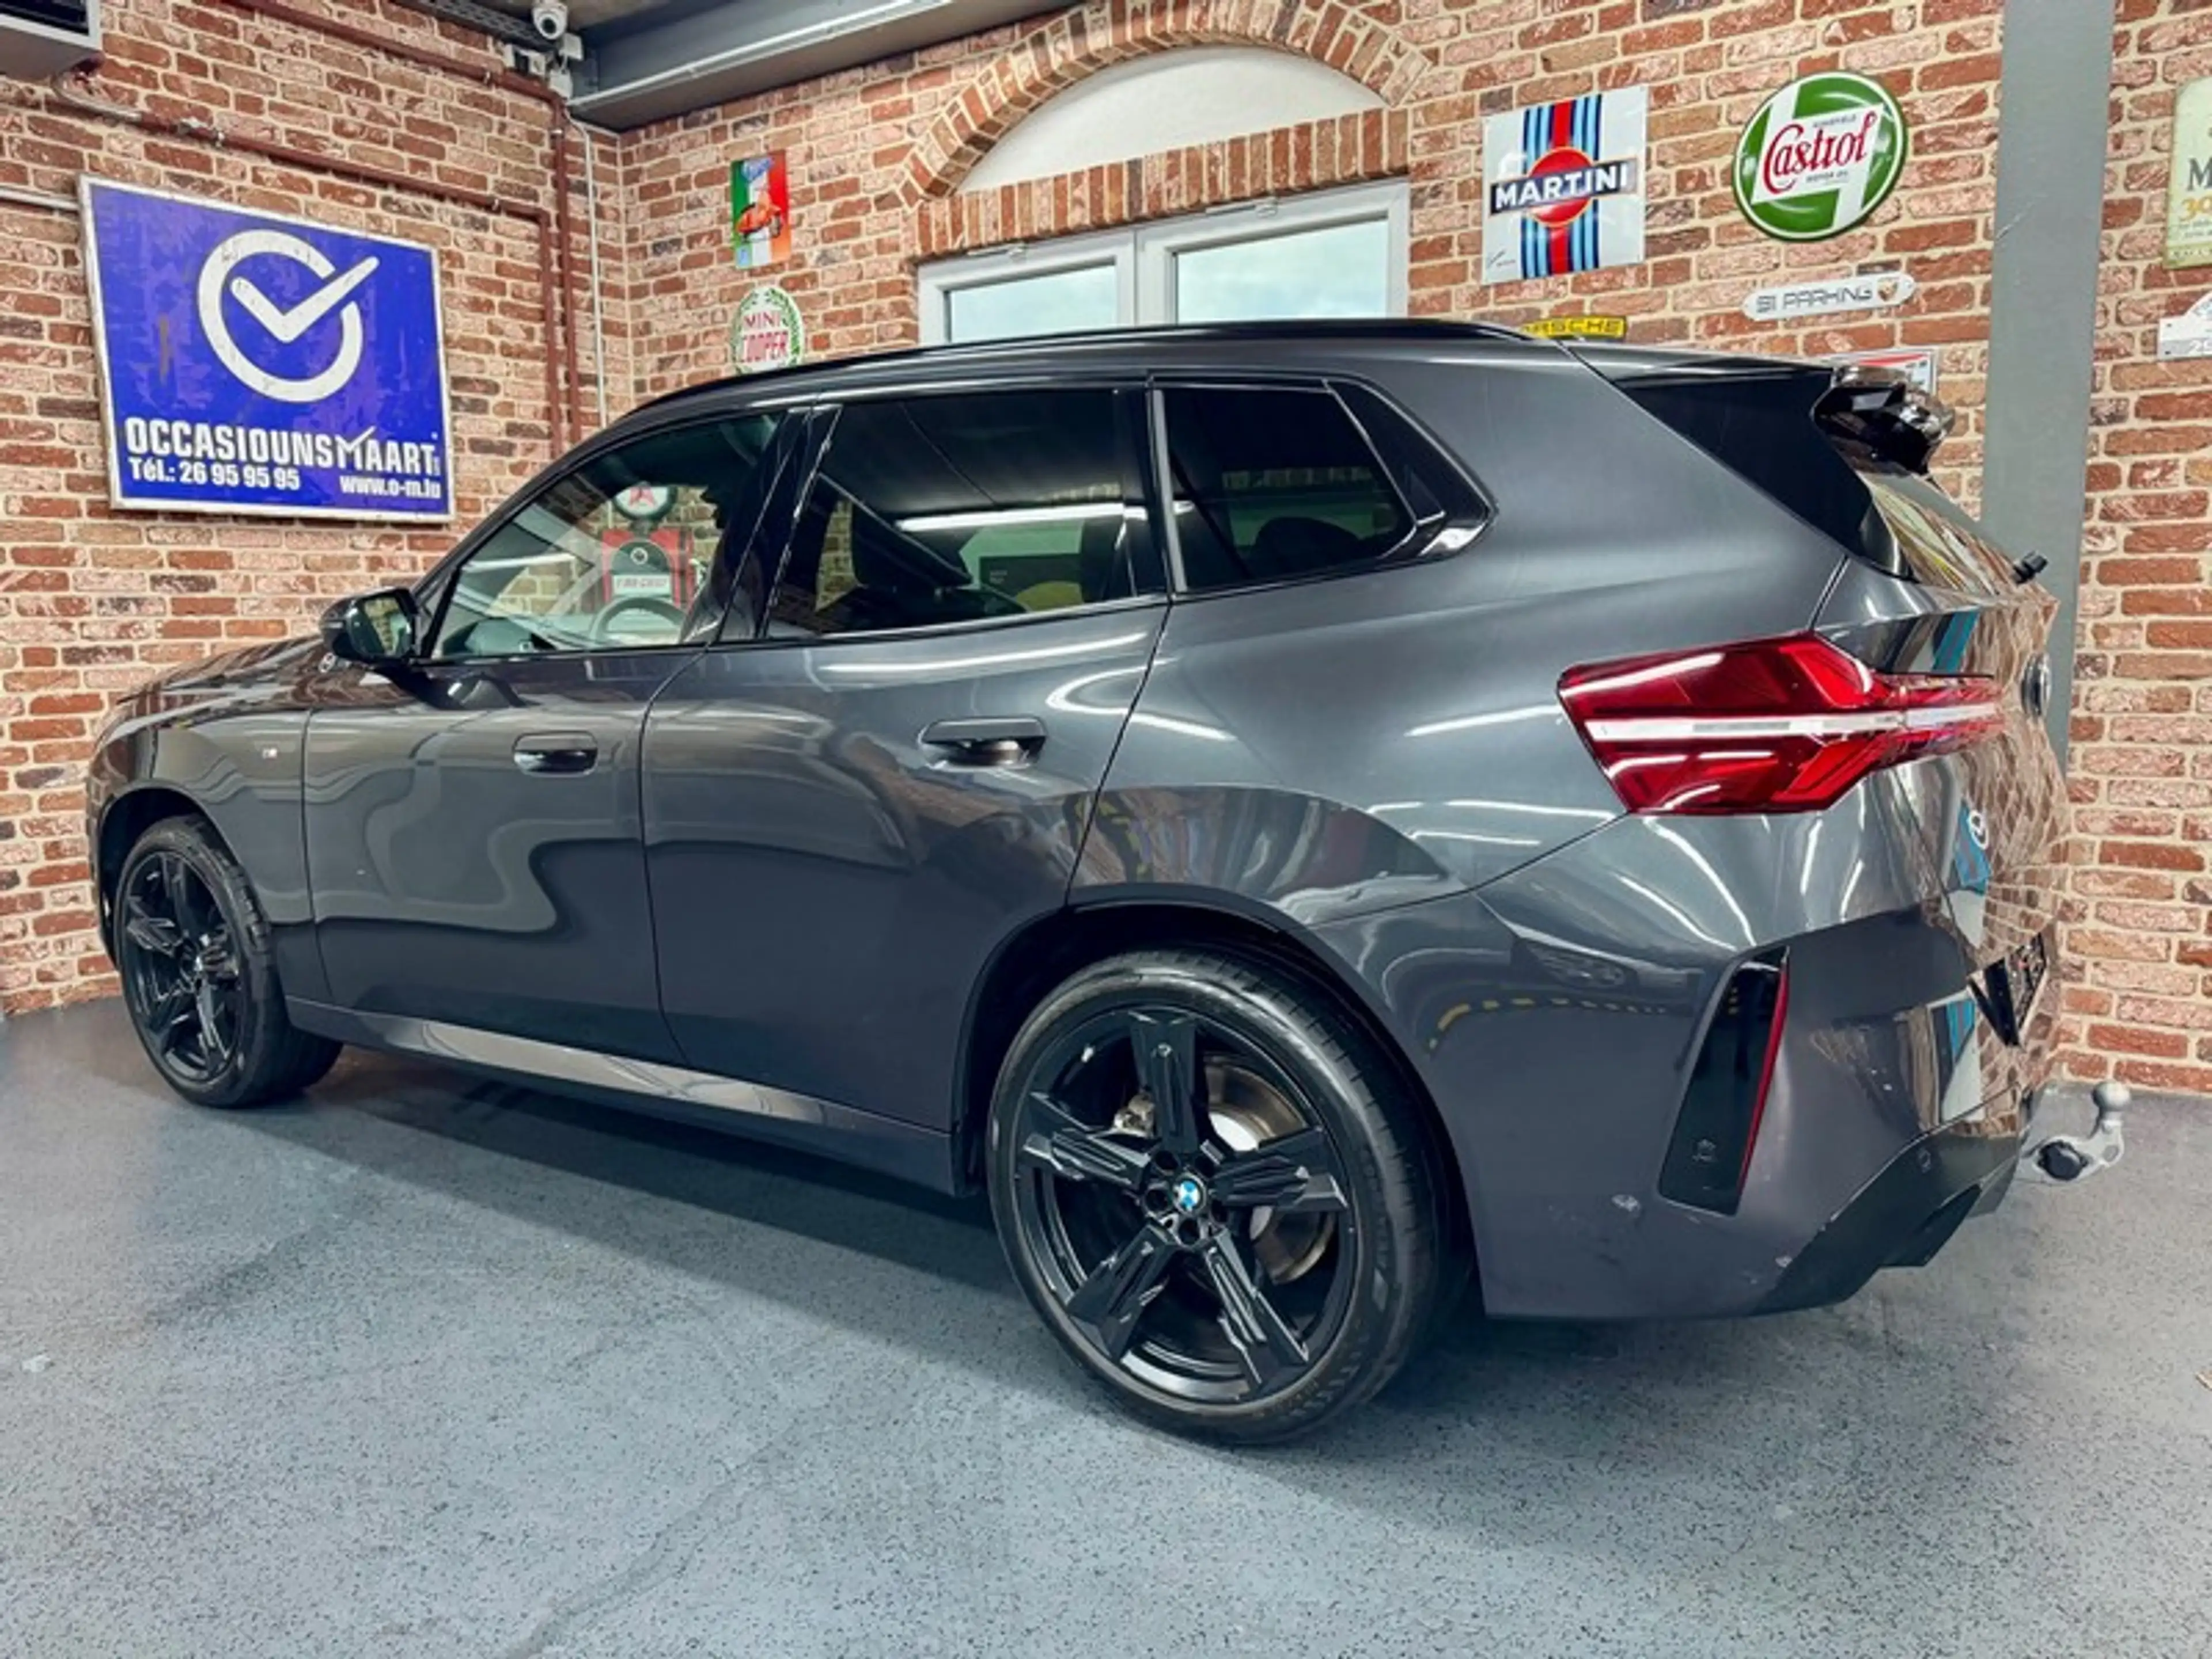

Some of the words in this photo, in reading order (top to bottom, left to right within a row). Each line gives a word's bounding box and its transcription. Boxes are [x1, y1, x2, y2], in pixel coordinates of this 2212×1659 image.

[1763, 110, 1878, 195] Castrol
[1495, 164, 1628, 209] MARTINI
[1783, 285, 1873, 309] PARKING
[179, 461, 207, 484] 26
[210, 463, 239, 487] 95
[243, 464, 270, 489] 95
[273, 467, 300, 490] 95
